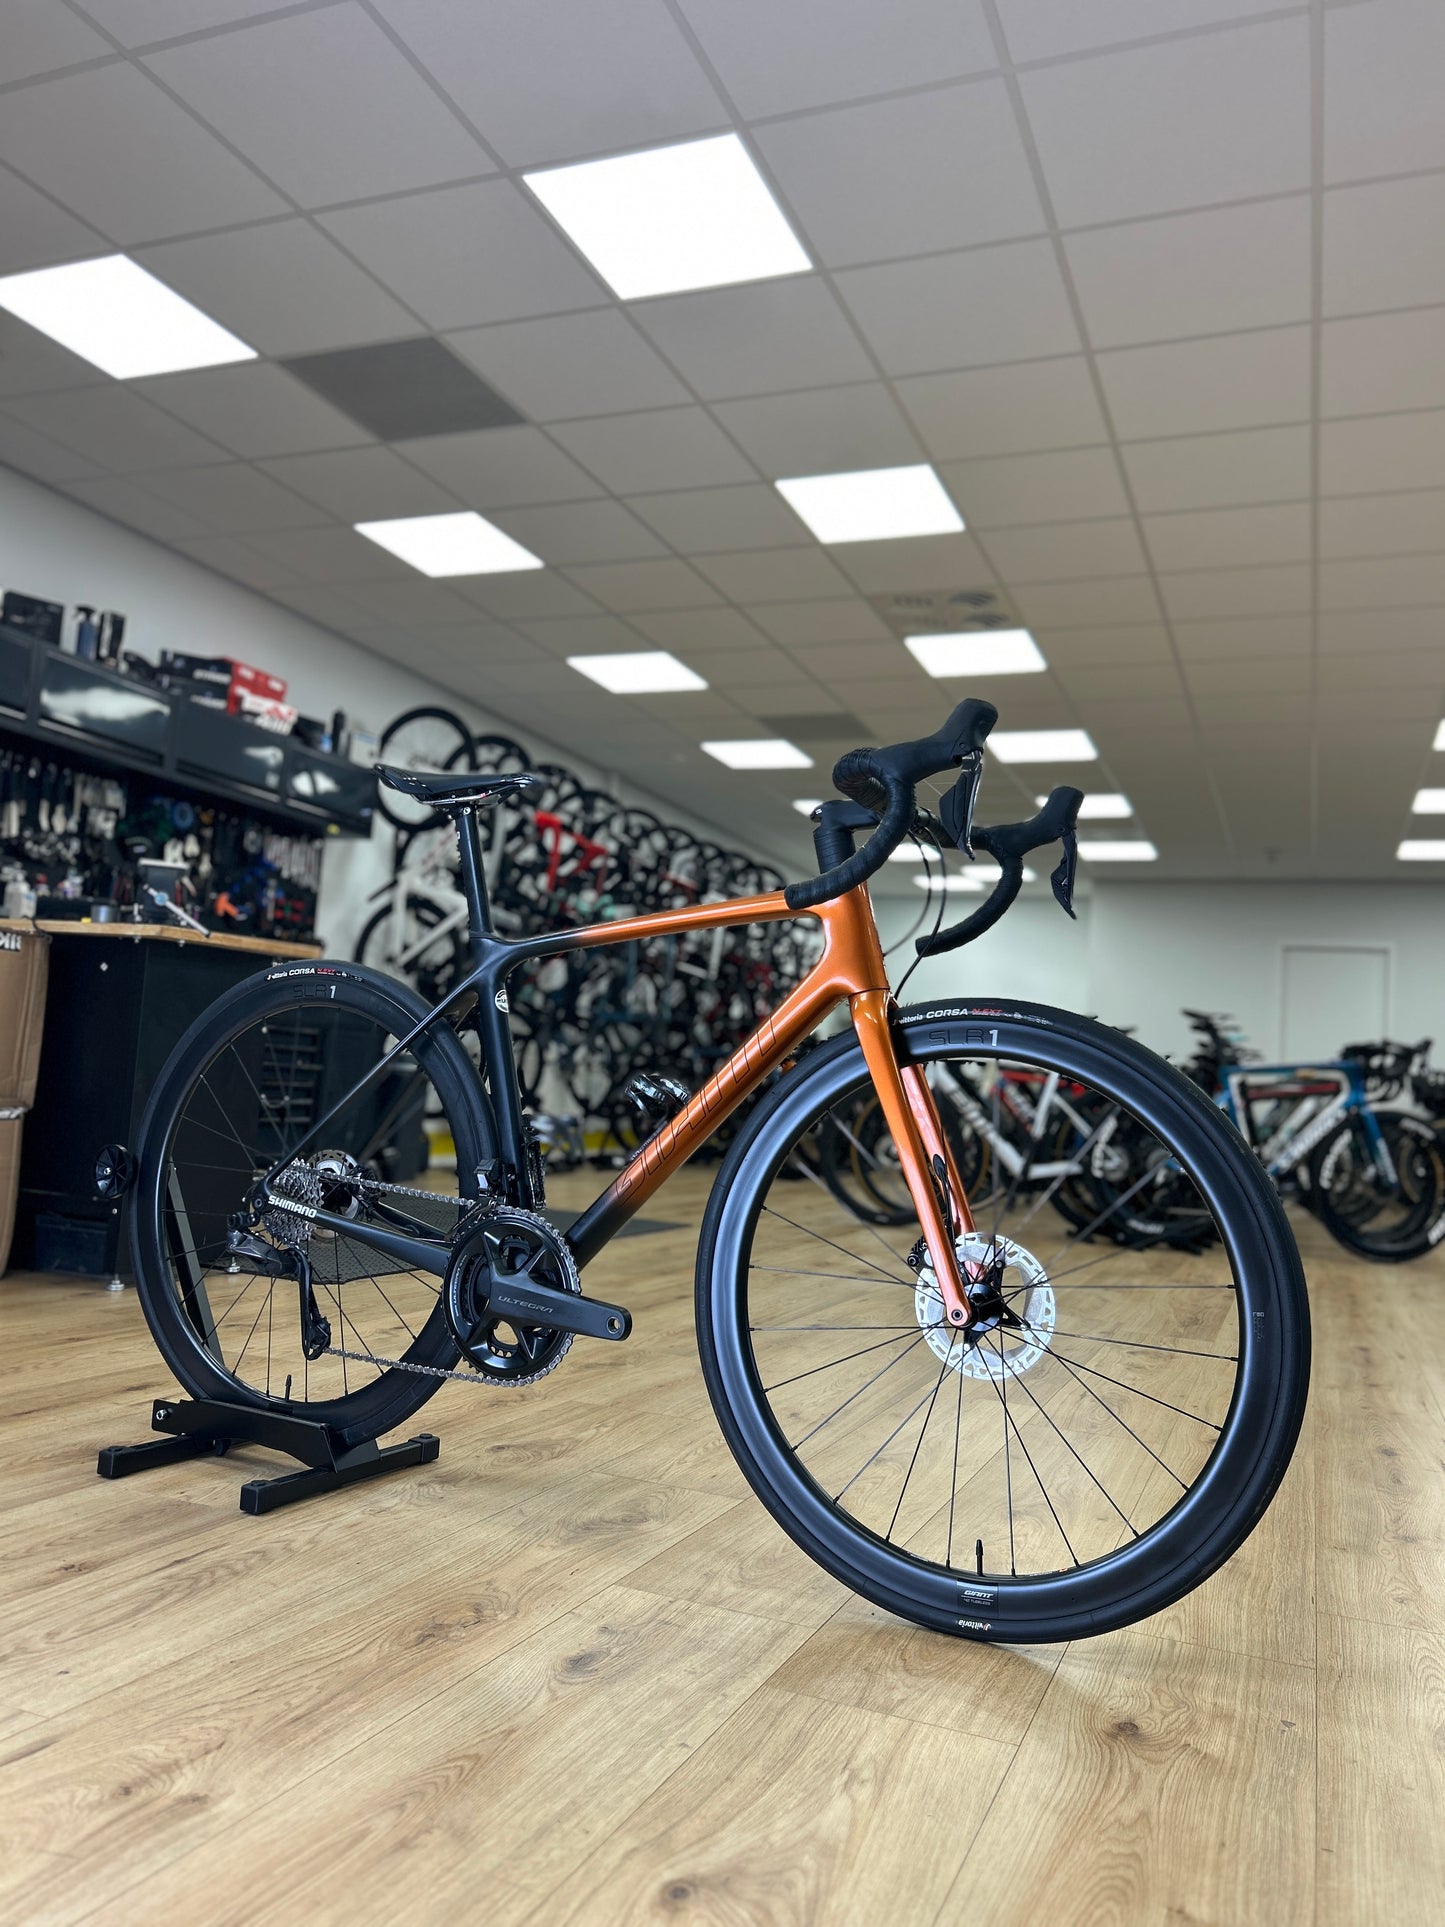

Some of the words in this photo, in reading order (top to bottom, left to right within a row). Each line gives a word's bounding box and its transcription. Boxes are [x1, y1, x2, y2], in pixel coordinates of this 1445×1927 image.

[288, 968, 315, 976] CORSA
[926, 1008, 968, 1019] CORSA
[267, 1194, 318, 1219] SHIMANO
[497, 1295, 553, 1314] ULTEGRA
[963, 1590, 994, 1599] GIANT
